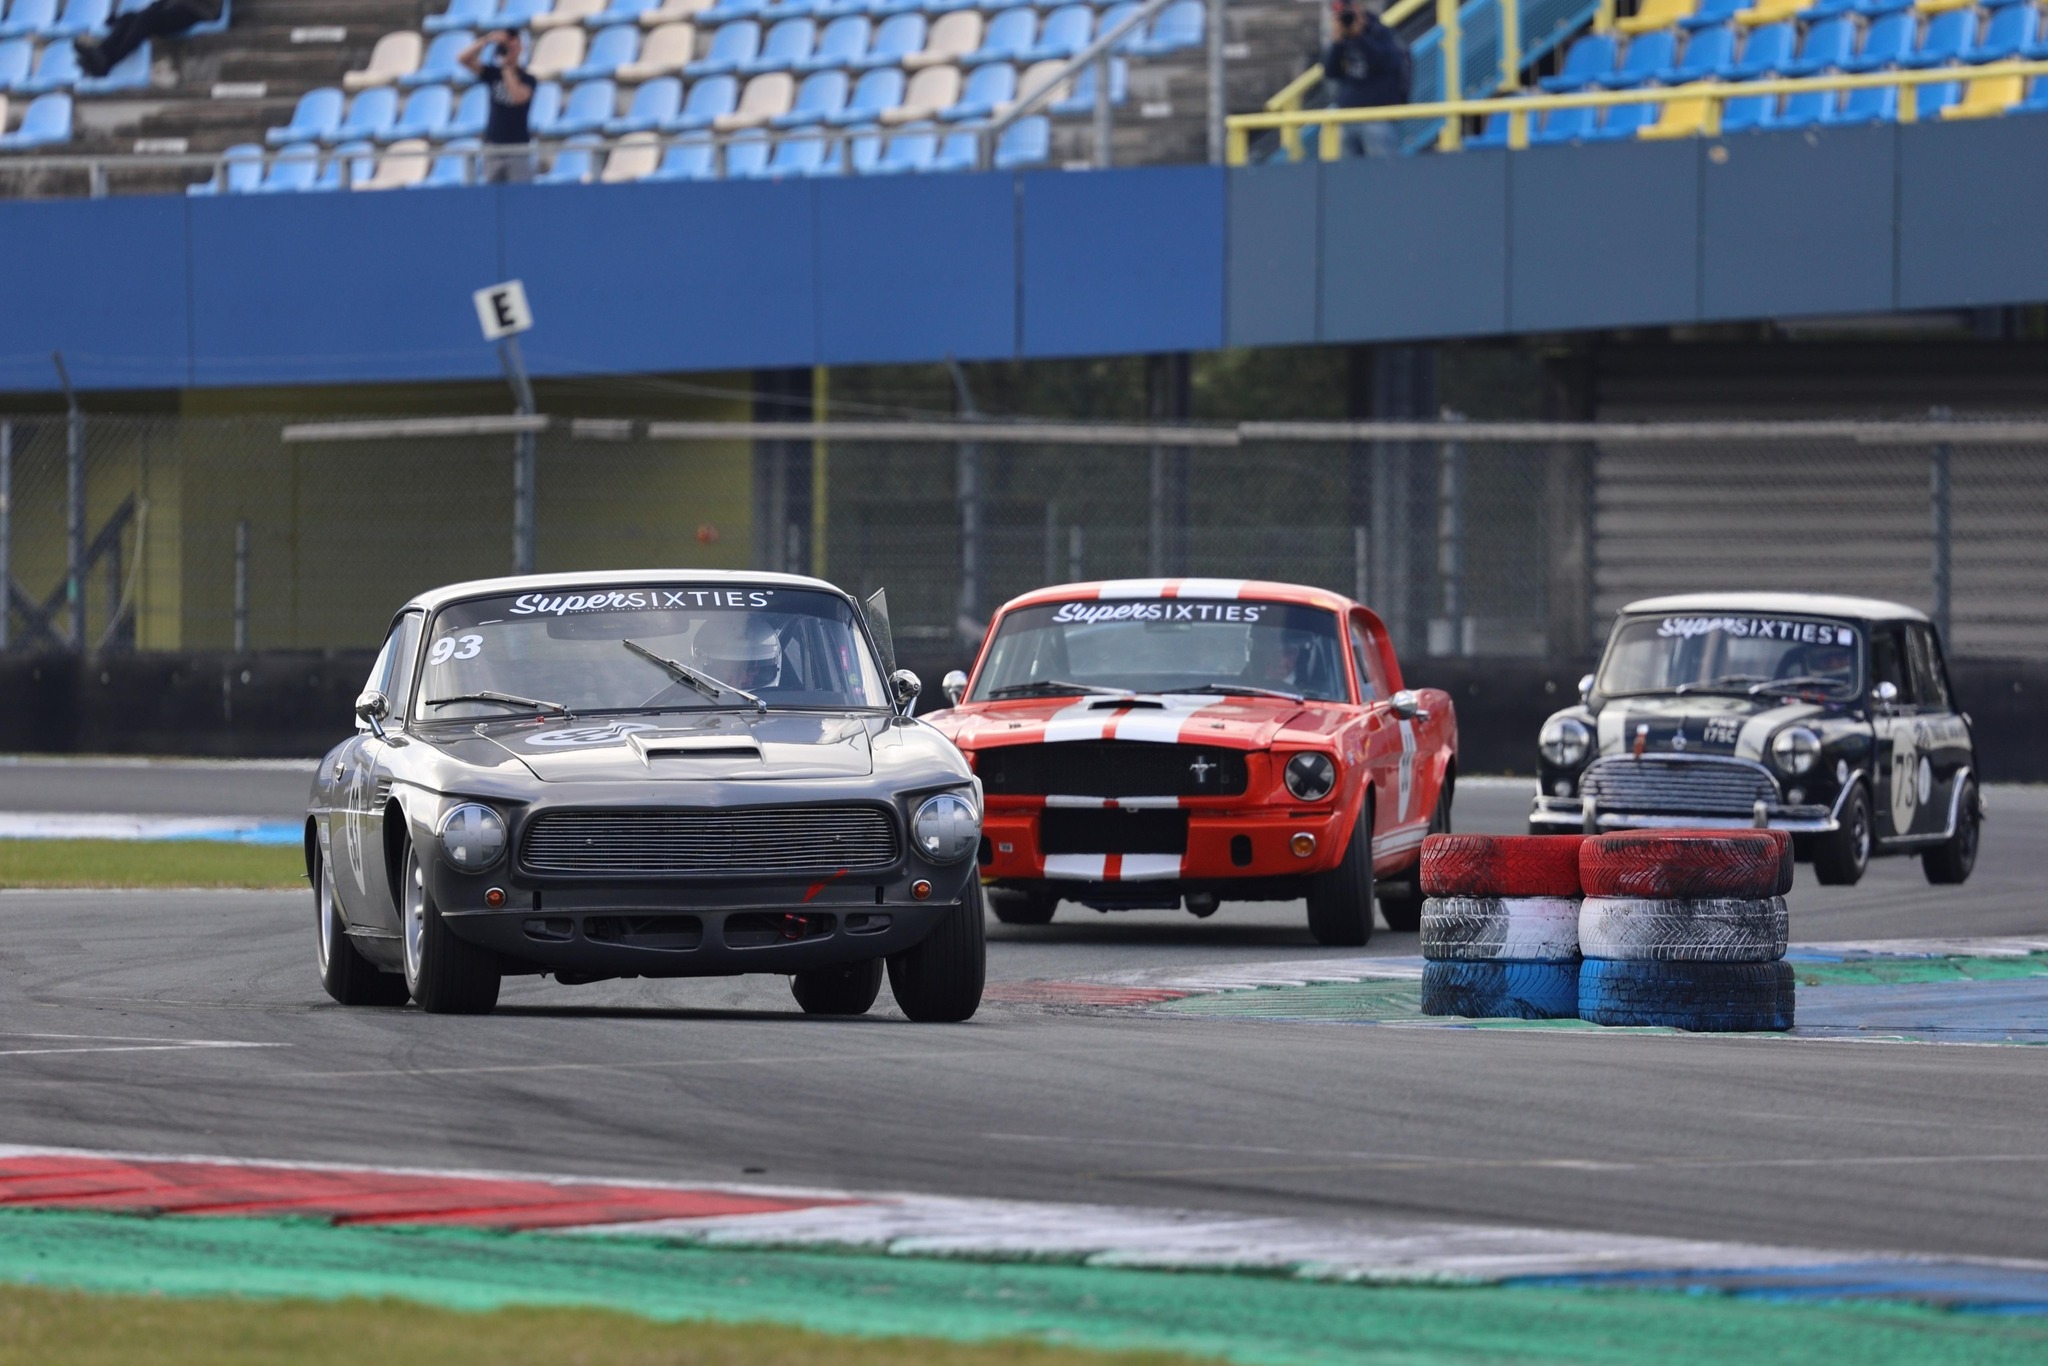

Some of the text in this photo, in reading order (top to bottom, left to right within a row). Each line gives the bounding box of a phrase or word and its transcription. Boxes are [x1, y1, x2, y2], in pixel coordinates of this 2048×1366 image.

[492, 292, 516, 328] E
[430, 634, 484, 666] 93
[1895, 752, 1915, 808] 73
